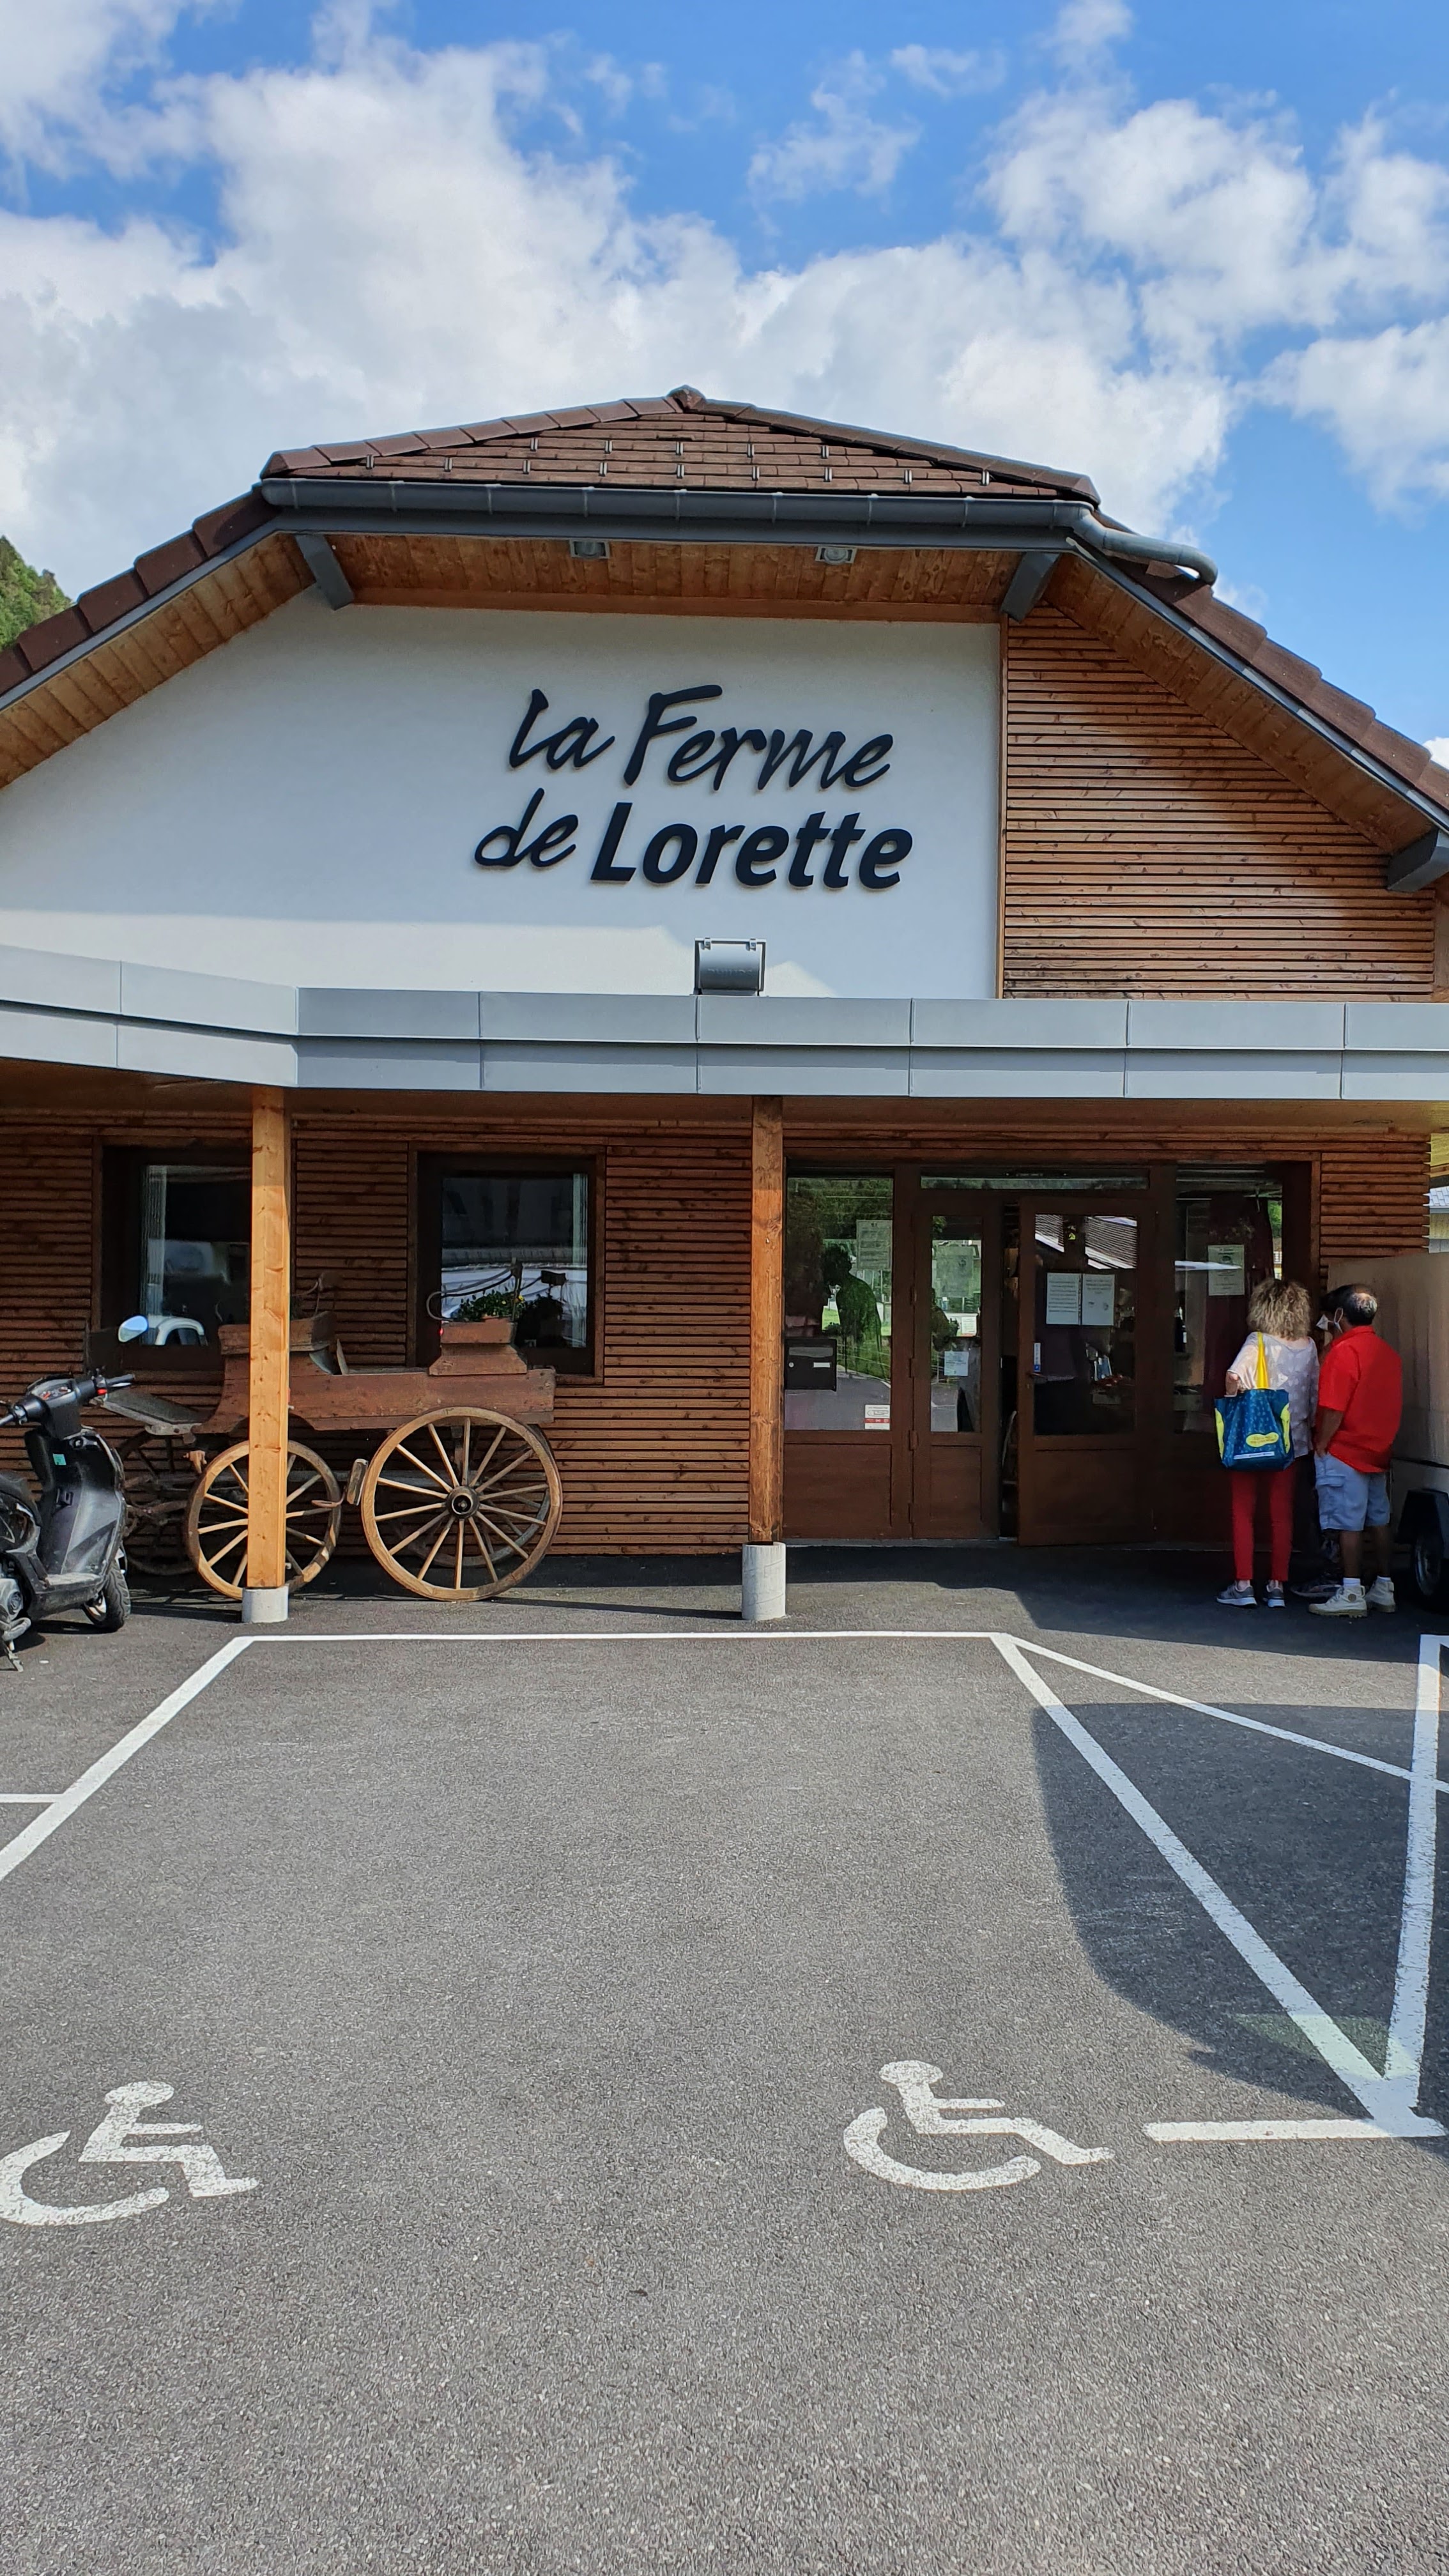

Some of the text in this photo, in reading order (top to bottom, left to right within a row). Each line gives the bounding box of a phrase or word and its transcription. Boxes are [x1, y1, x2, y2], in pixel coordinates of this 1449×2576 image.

[624, 684, 893, 791] Ferme
[474, 788, 914, 889] de Lorette
